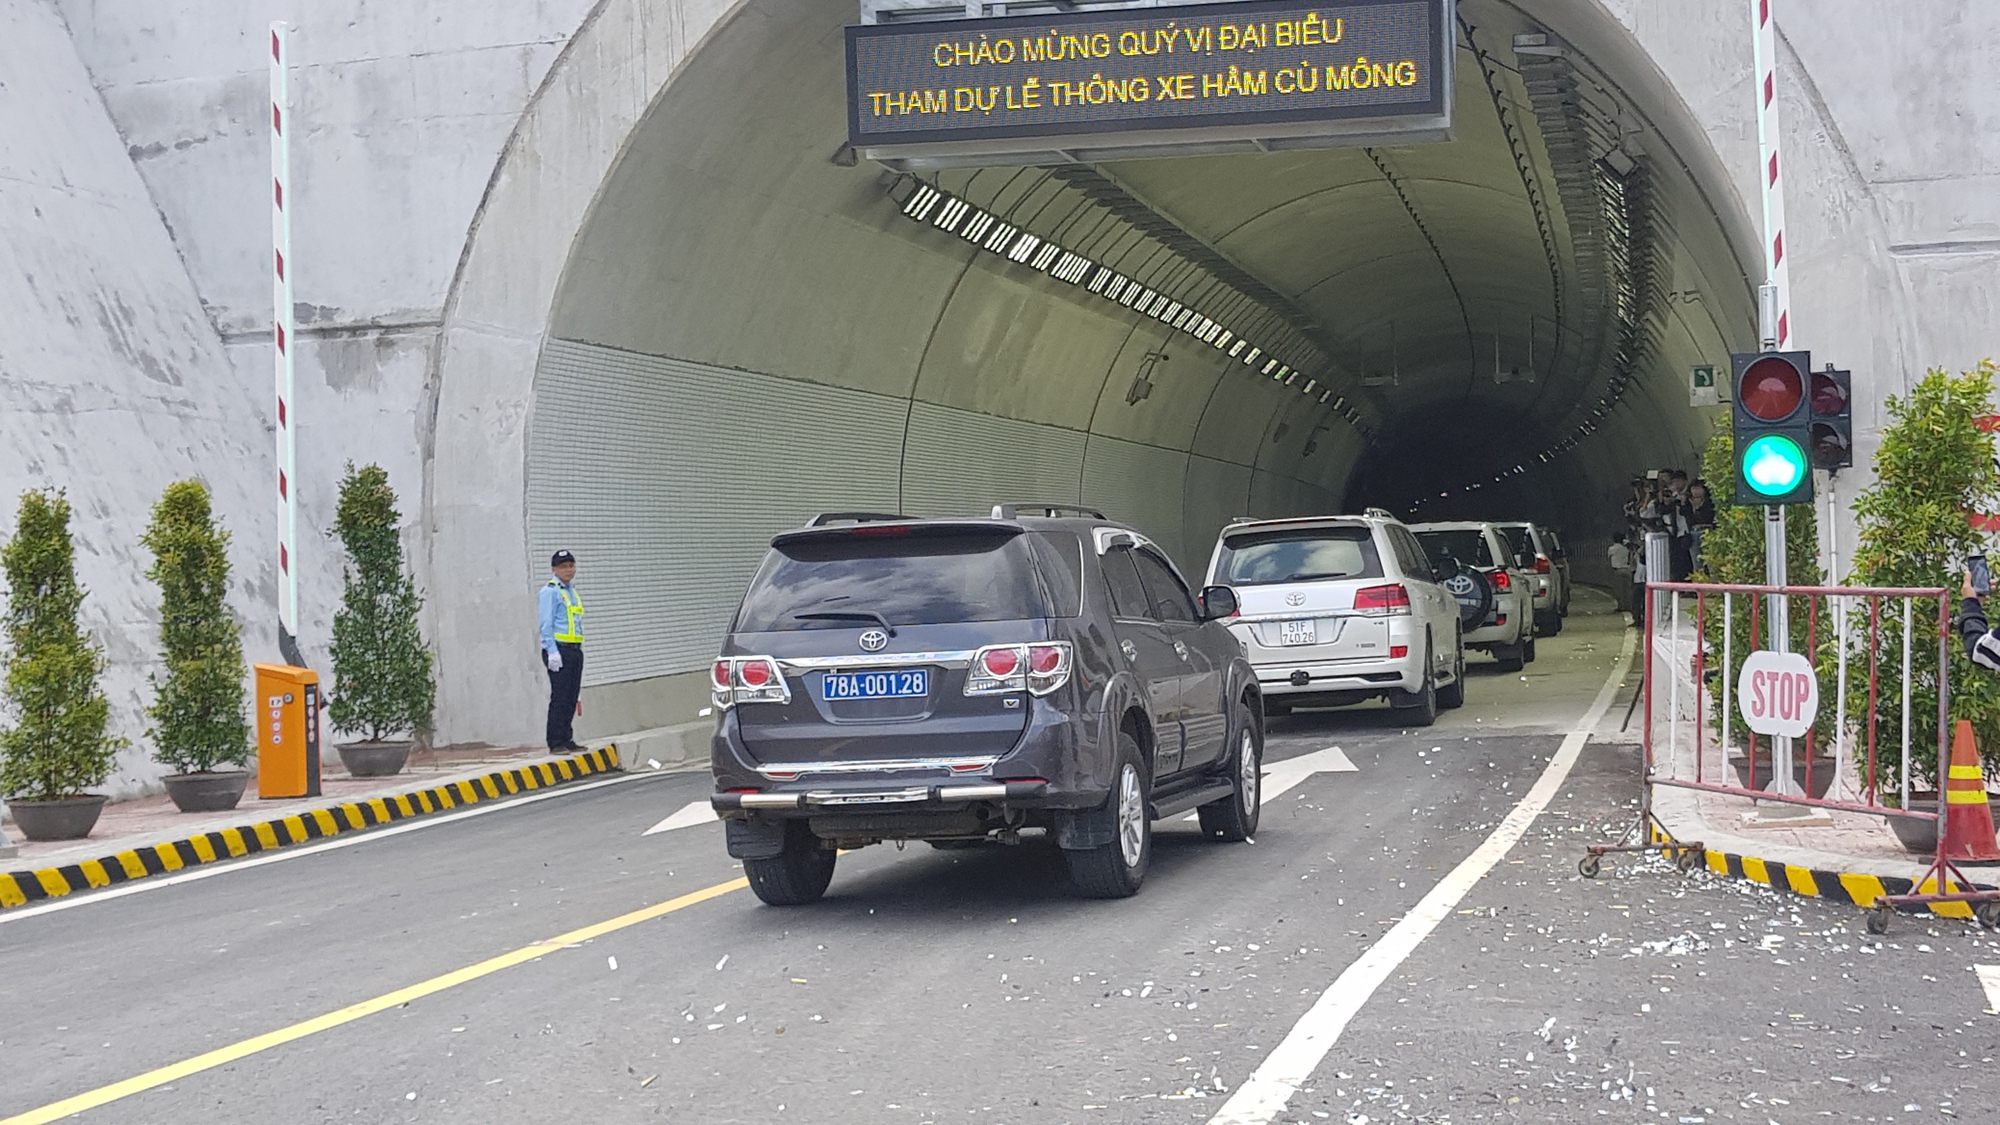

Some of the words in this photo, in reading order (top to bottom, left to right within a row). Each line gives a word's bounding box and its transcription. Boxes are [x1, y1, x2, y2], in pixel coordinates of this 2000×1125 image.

[933, 34, 1016, 67] CHÀO
[1022, 28, 1110, 61] MỪNG
[1118, 21, 1180, 56] QUÝ
[1183, 26, 1213, 56] VỊ
[1218, 22, 1268, 54] ĐẠI
[867, 90, 948, 116] THAM
[954, 85, 1000, 116] DỰ
[1048, 72, 1149, 106] THÔNG
[1155, 73, 1195, 101] XE
[1274, 60, 1318, 94] CÙ
[1325, 56, 1417, 91] MÔNG
[1288, 621, 1306, 633] 51F
[826, 673, 924, 697] 78A-001.28
[1751, 669, 1810, 721] STOP
